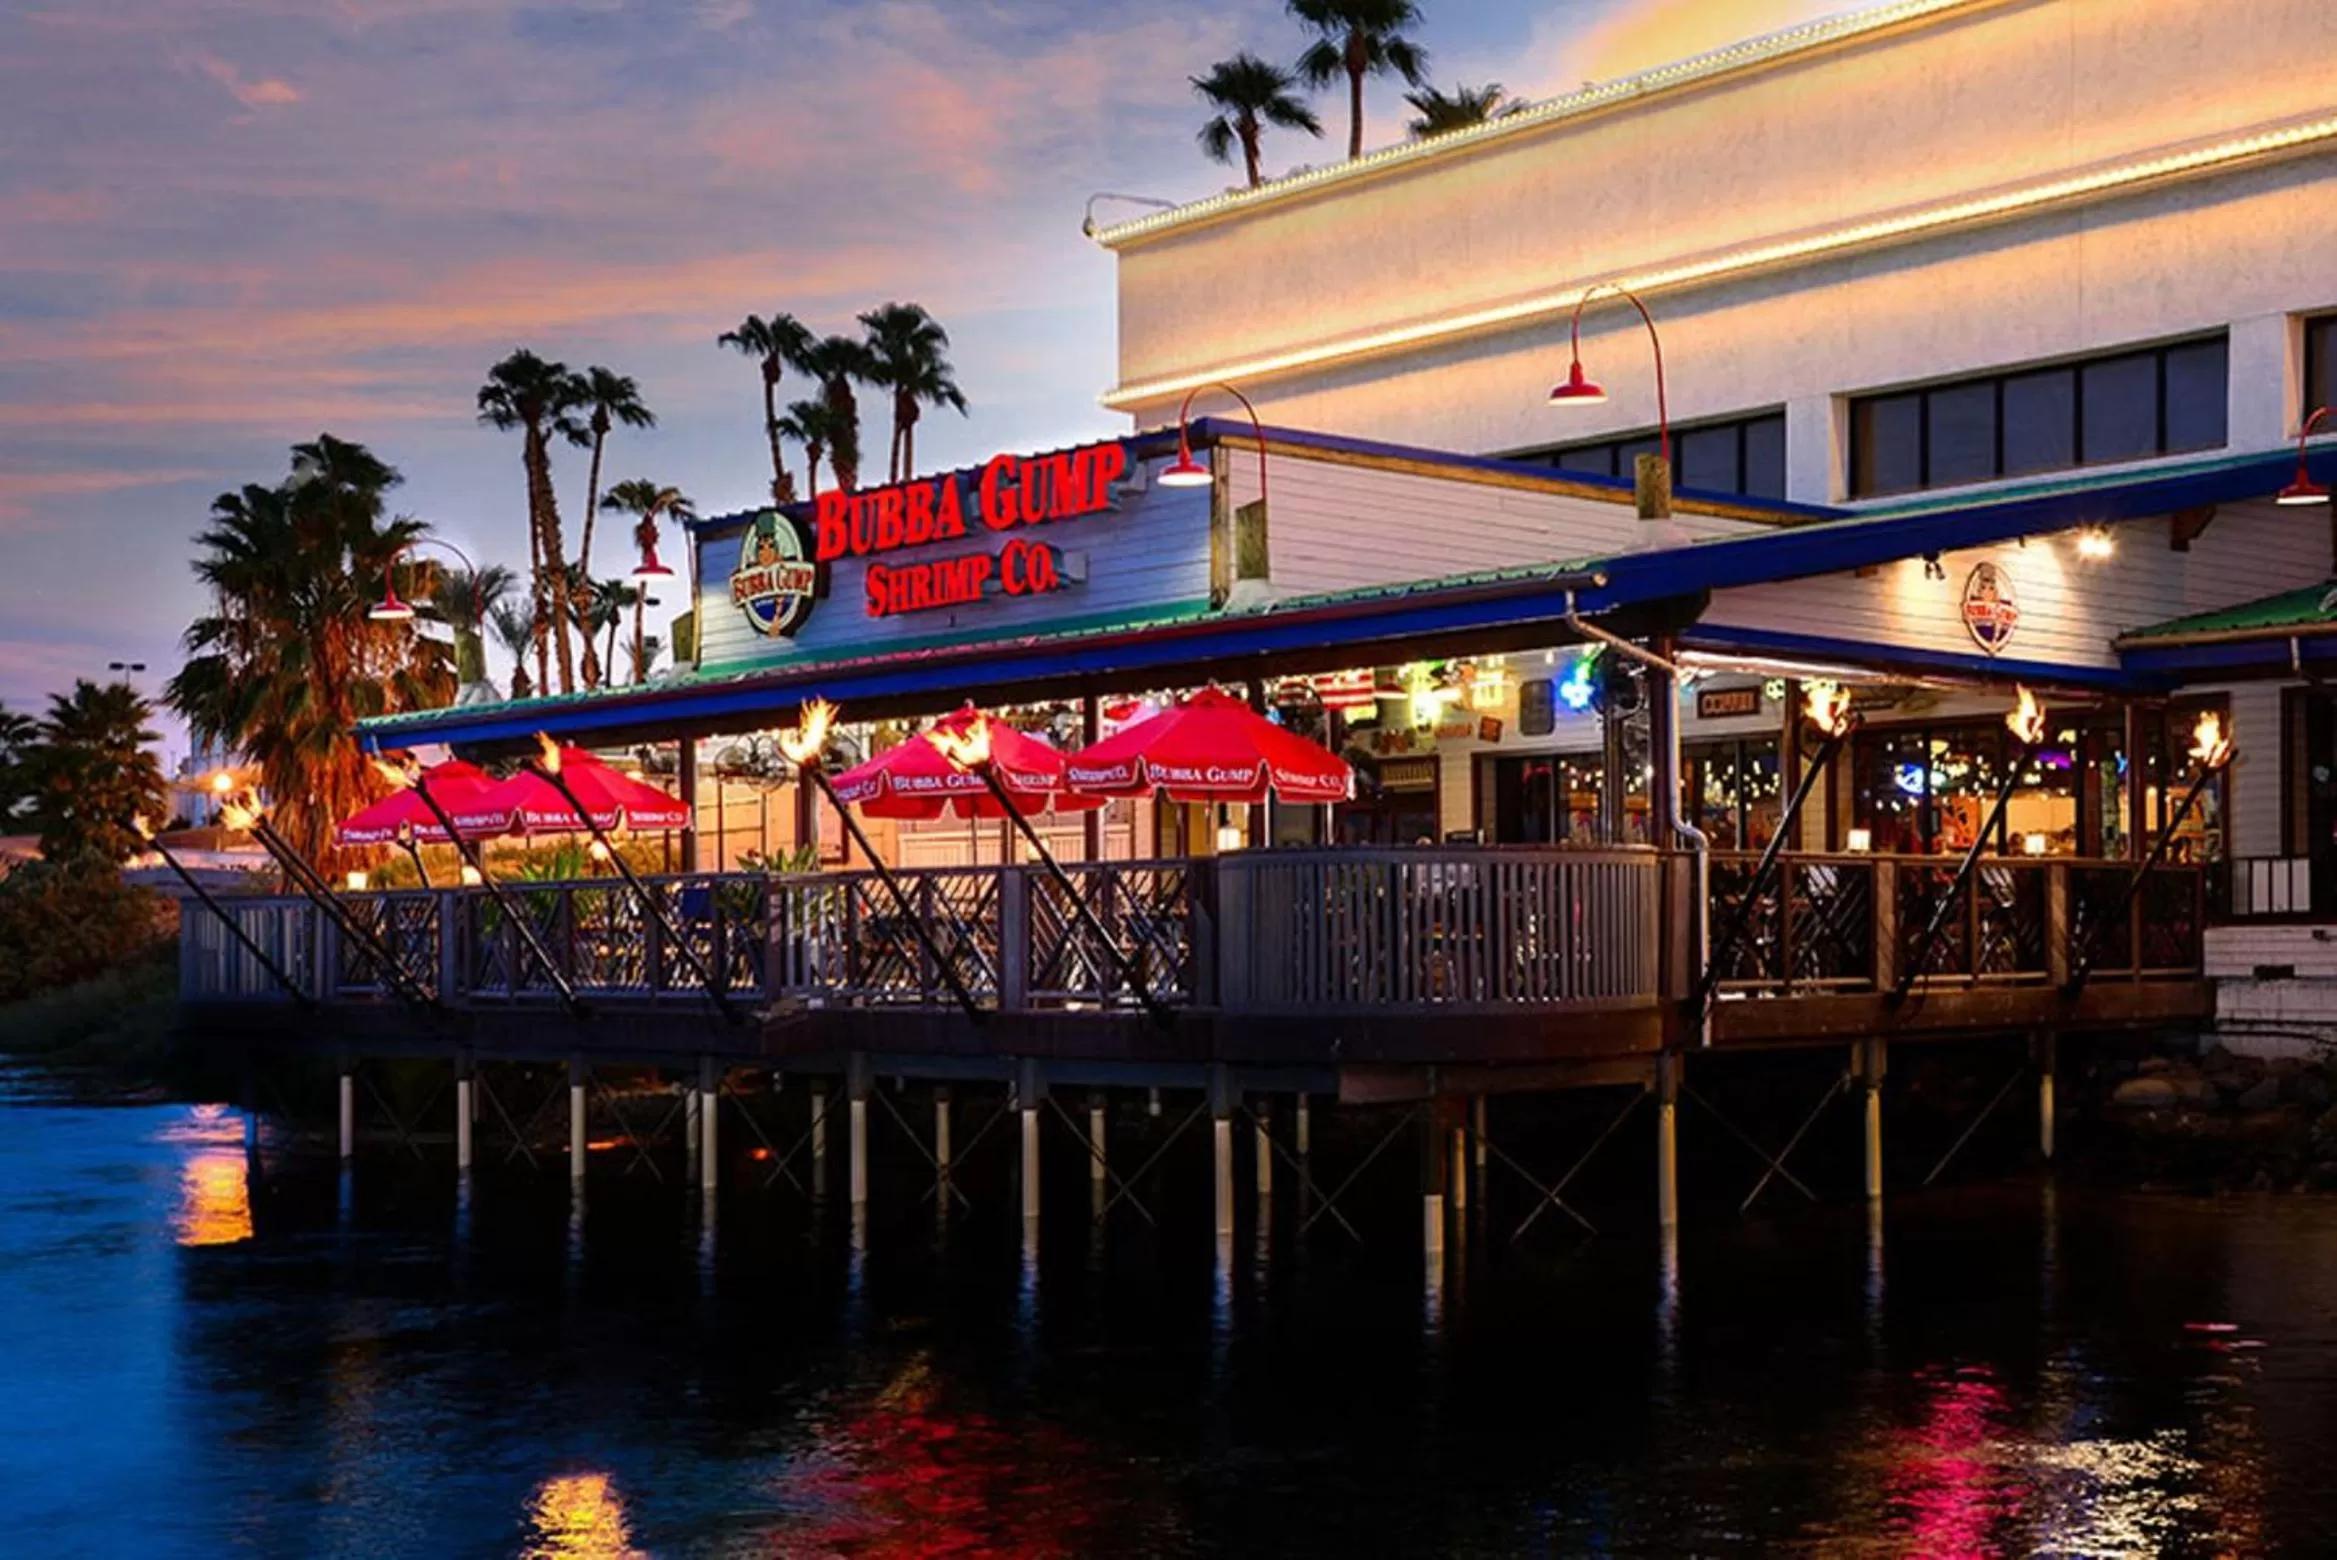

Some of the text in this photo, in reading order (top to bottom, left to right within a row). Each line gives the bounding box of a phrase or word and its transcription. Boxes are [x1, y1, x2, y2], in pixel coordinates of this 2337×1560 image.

[815, 442, 1125, 560] BUBBA GUMP
[866, 555, 992, 617] SHRIMP
[1150, 764, 1254, 782] BUBBA GUMP
